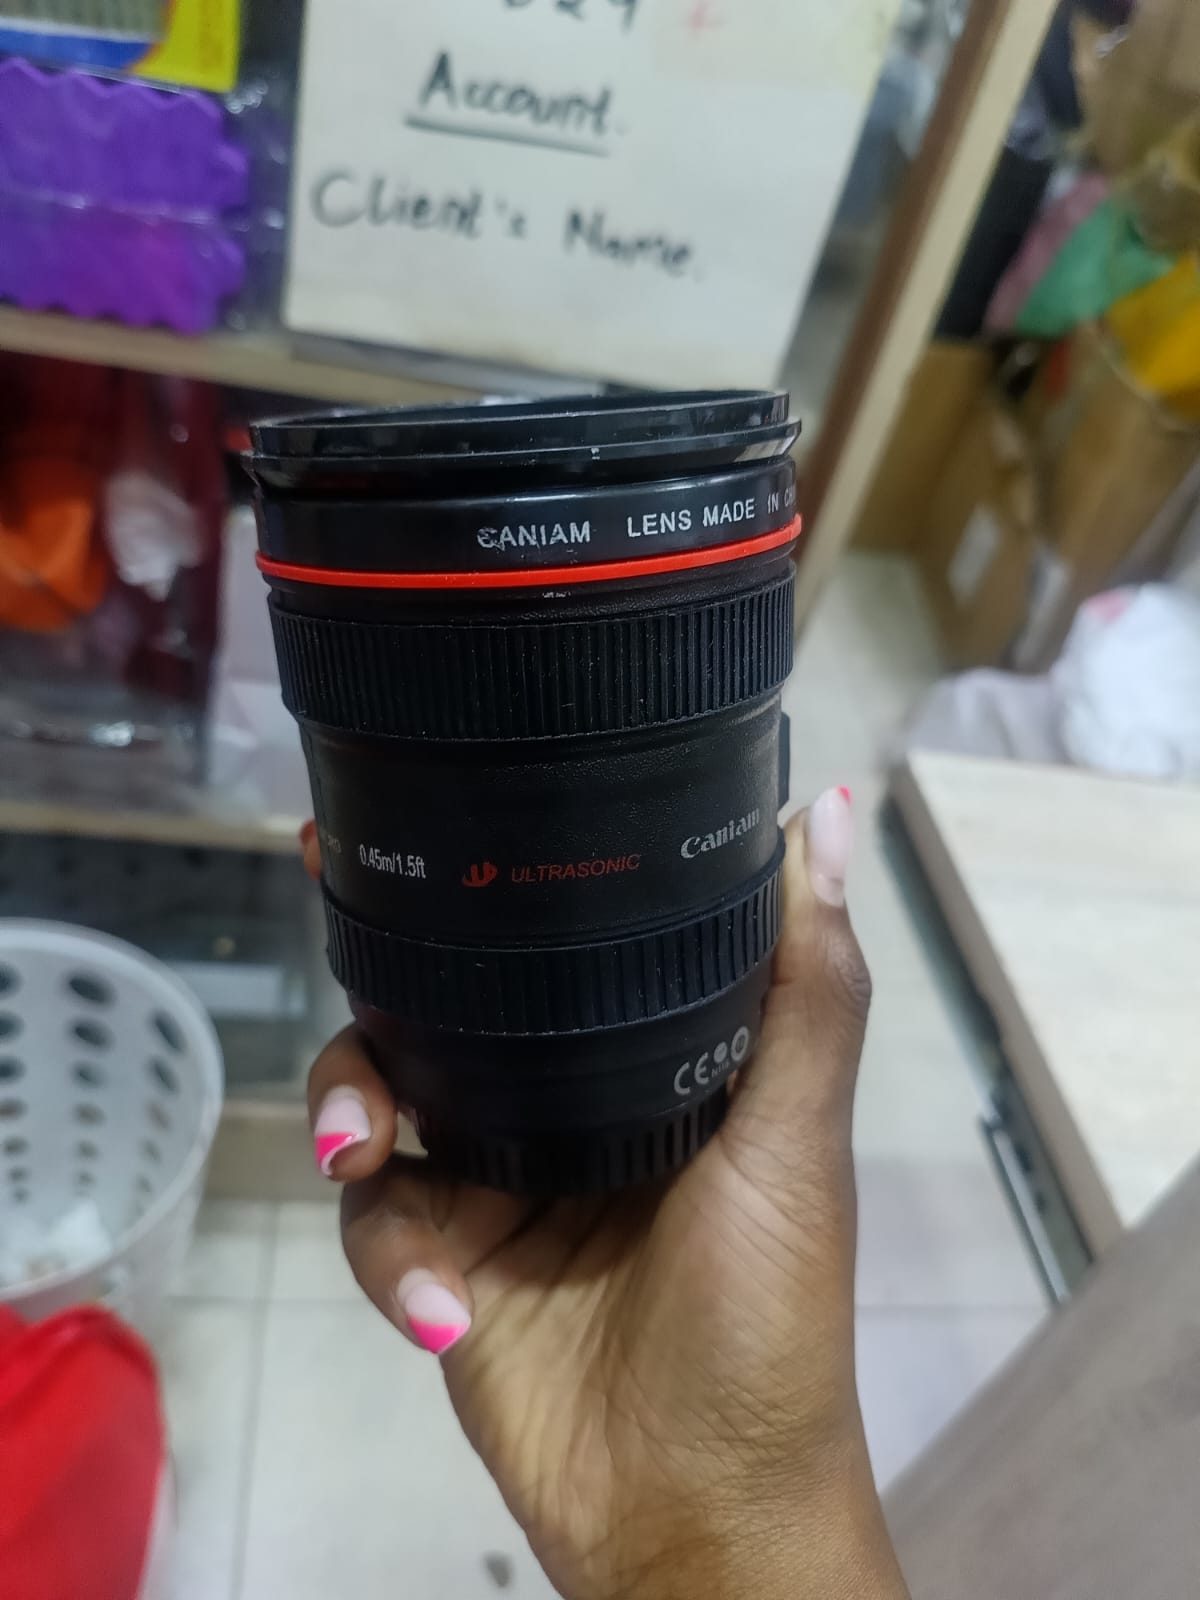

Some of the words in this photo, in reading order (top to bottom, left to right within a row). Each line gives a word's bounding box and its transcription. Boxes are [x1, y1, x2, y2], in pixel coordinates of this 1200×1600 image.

[627, 509, 692, 538] LENS
[702, 497, 756, 528] MADE
[767, 491, 779, 515] IN
[511, 853, 641, 883] ULTRASONIC
